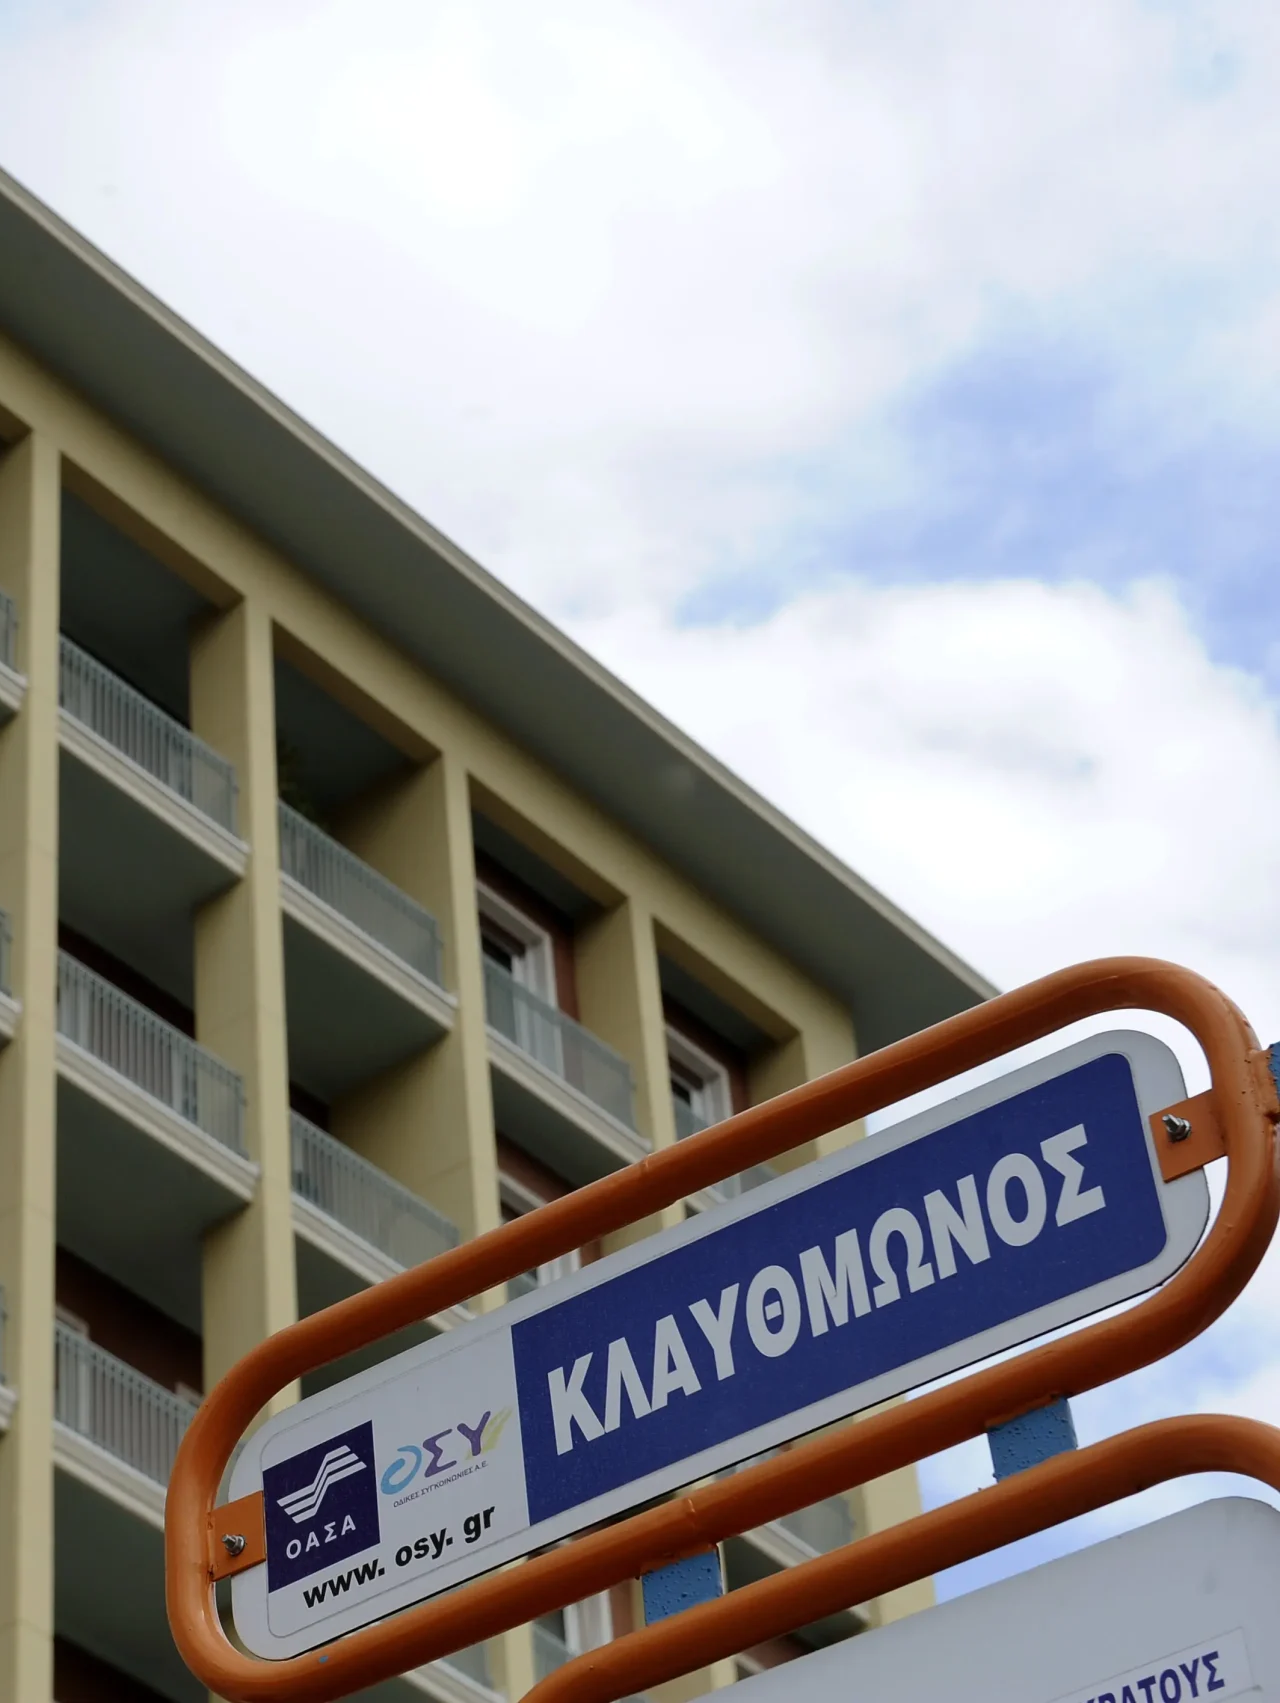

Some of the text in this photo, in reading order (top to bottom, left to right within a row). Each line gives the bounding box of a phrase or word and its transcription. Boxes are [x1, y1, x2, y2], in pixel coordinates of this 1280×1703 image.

[546, 1123, 1107, 1456] ΚΛΑΥΘΜΩΝΟΣ
[393, 1490, 420, 1508] ΟΔΙΚΕΣ
[285, 1514, 357, 1560] ΟΑΣΑ
[302, 1506, 495, 1609] www. osy. gr
